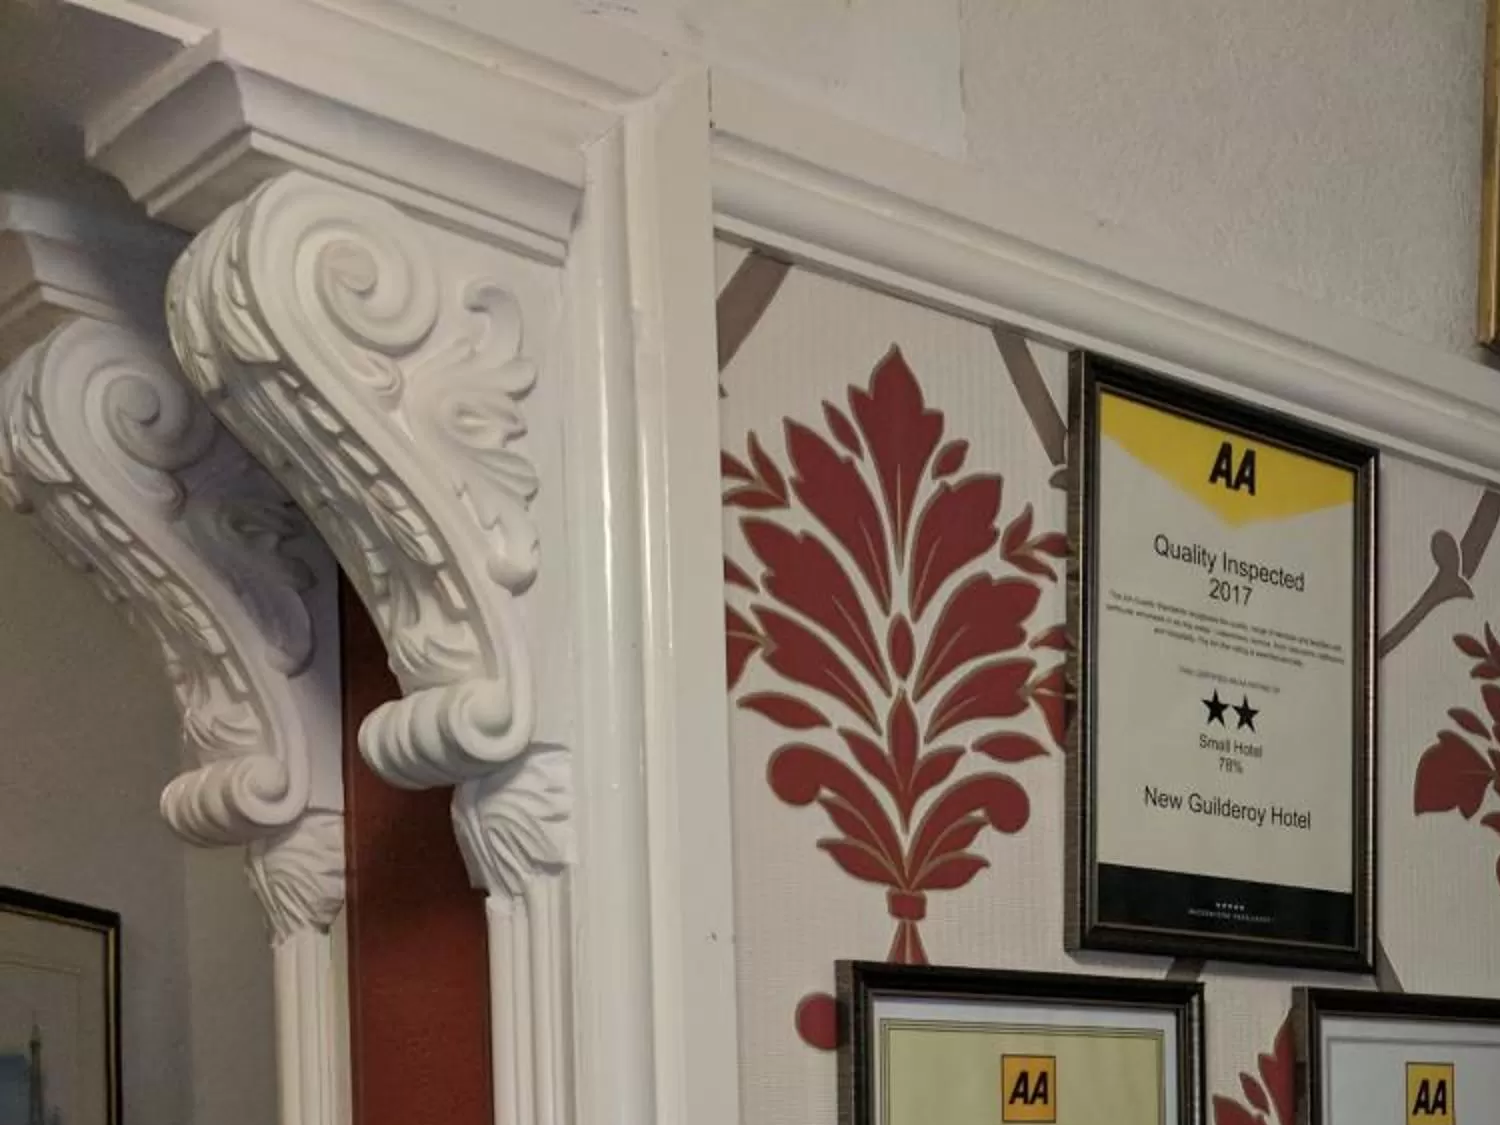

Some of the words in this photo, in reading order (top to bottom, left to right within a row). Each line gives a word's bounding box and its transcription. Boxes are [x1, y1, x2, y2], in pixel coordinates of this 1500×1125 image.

[1209, 441, 1256, 496] AA
[1154, 534, 1217, 573] Quality
[1222, 552, 1305, 592] Inspected
[1209, 578, 1252, 605] 2017
[1199, 734, 1230, 754] Small
[1234, 739, 1263, 758] Hotel
[1144, 785, 1183, 810] New
[1188, 793, 1266, 827] Guilderoy
[1271, 809, 1311, 830] Hotel
[1009, 1071, 1049, 1105] AA
[1412, 1079, 1447, 1116] AA
